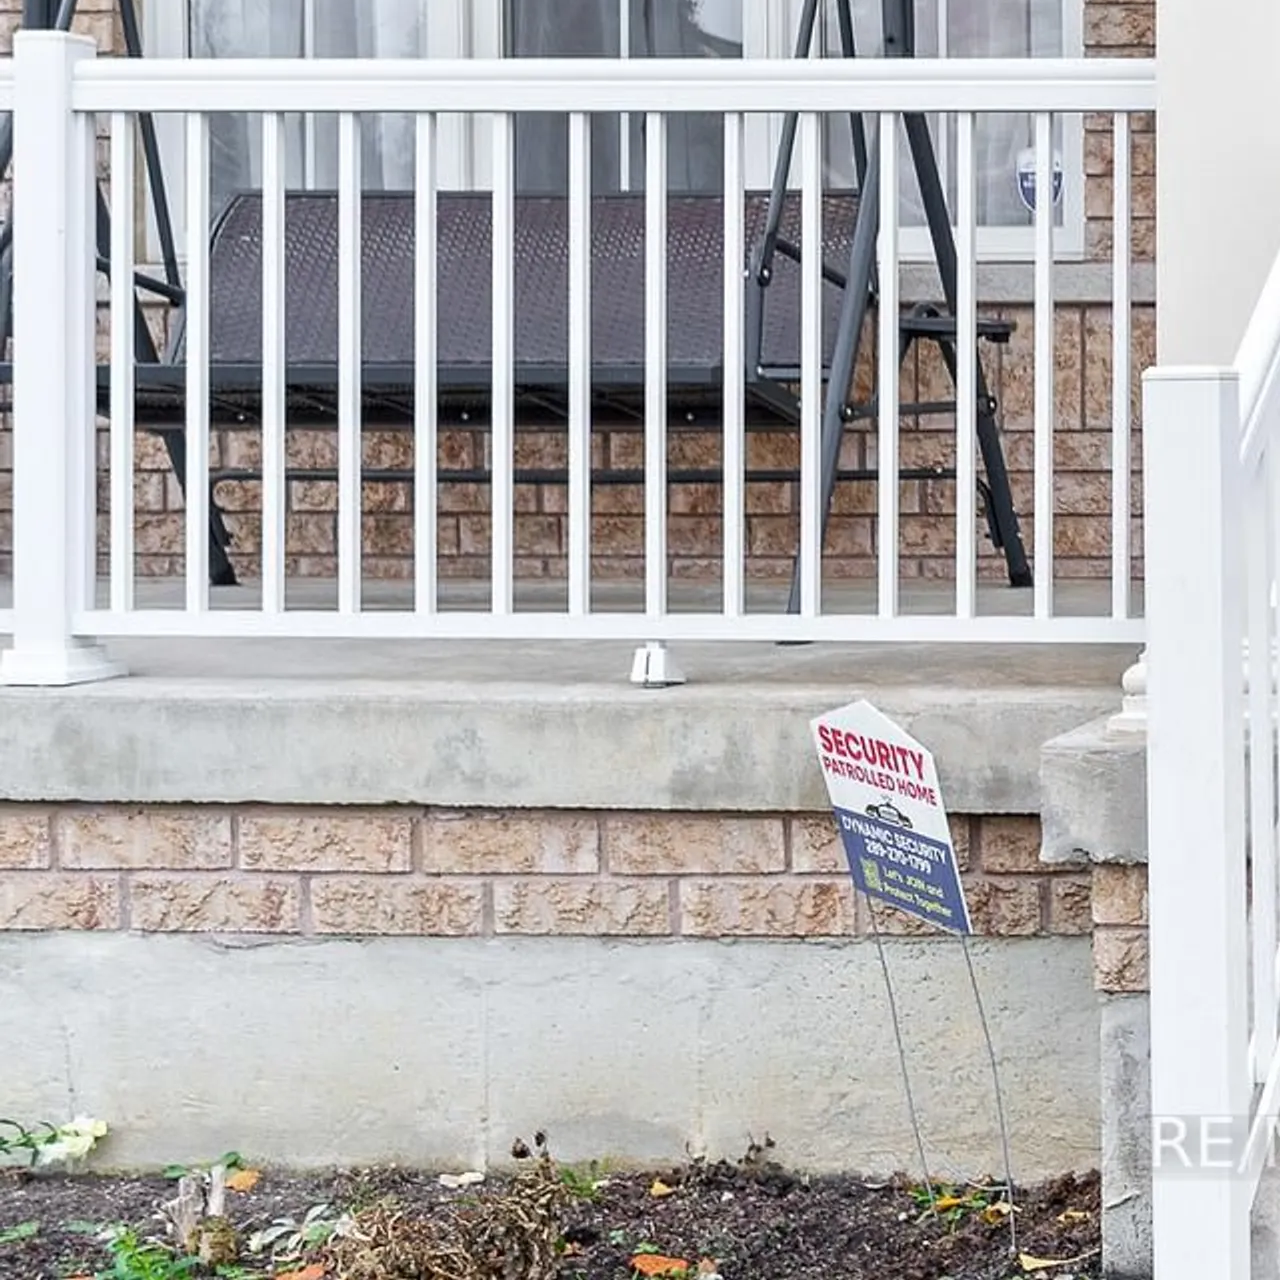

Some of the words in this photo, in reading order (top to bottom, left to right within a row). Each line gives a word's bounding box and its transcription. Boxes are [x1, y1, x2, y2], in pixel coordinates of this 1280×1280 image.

[818, 725, 923, 780] SECURITY
[823, 756, 895, 791] PATROLLED
[897, 778, 937, 807] HOME
[842, 815, 893, 845] DYNAMIC
[894, 832, 945, 865] SECURITY
